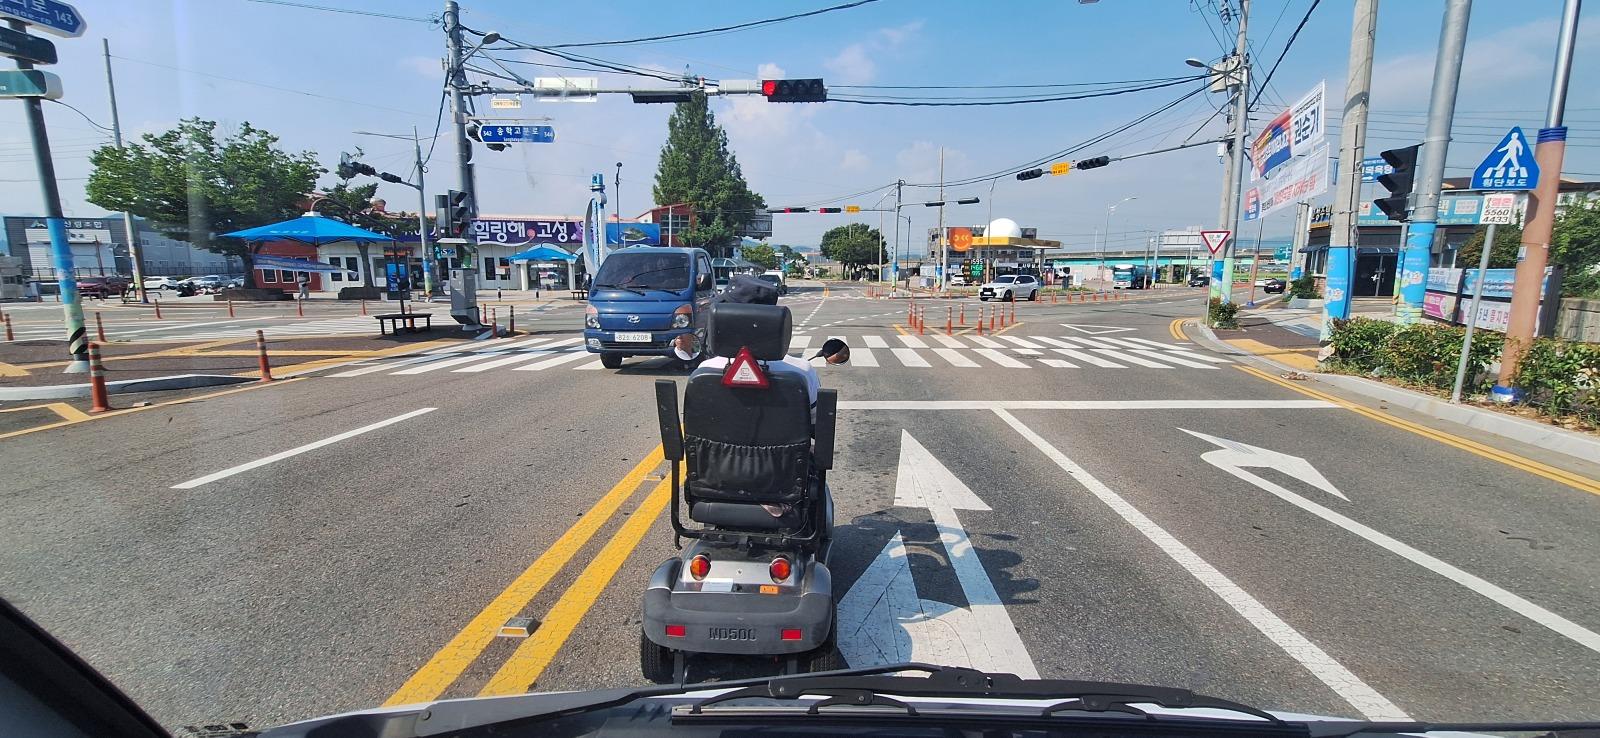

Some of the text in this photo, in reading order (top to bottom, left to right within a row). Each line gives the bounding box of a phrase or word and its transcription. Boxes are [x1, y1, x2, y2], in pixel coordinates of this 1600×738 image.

[54, 9, 73, 25] 143
[1482, 178, 1527, 187] 횡단보도
[474, 221, 568, 244] 힐링해 고성
